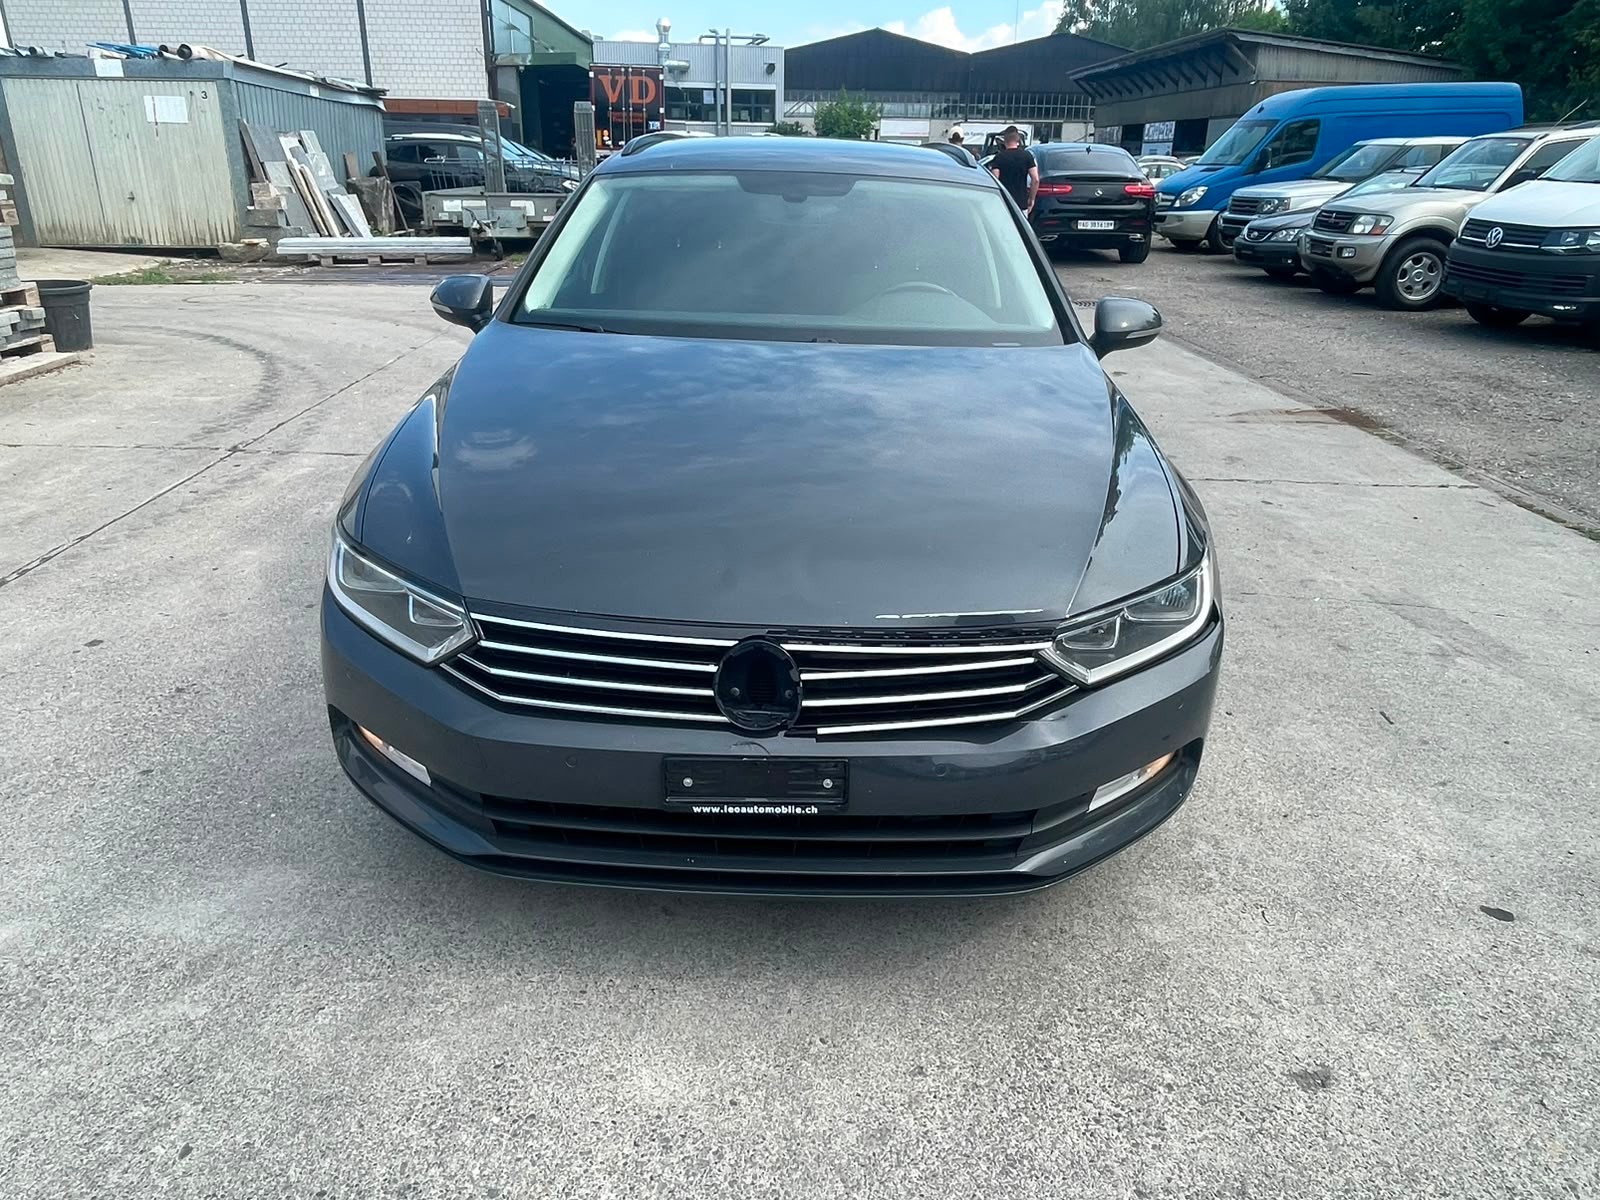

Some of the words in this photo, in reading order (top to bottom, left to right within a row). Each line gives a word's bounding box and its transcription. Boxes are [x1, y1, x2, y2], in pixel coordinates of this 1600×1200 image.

[598, 74, 656, 104] VD
[200, 90, 208, 99] 3
[692, 804, 819, 814] www.leoautomobile.ch
